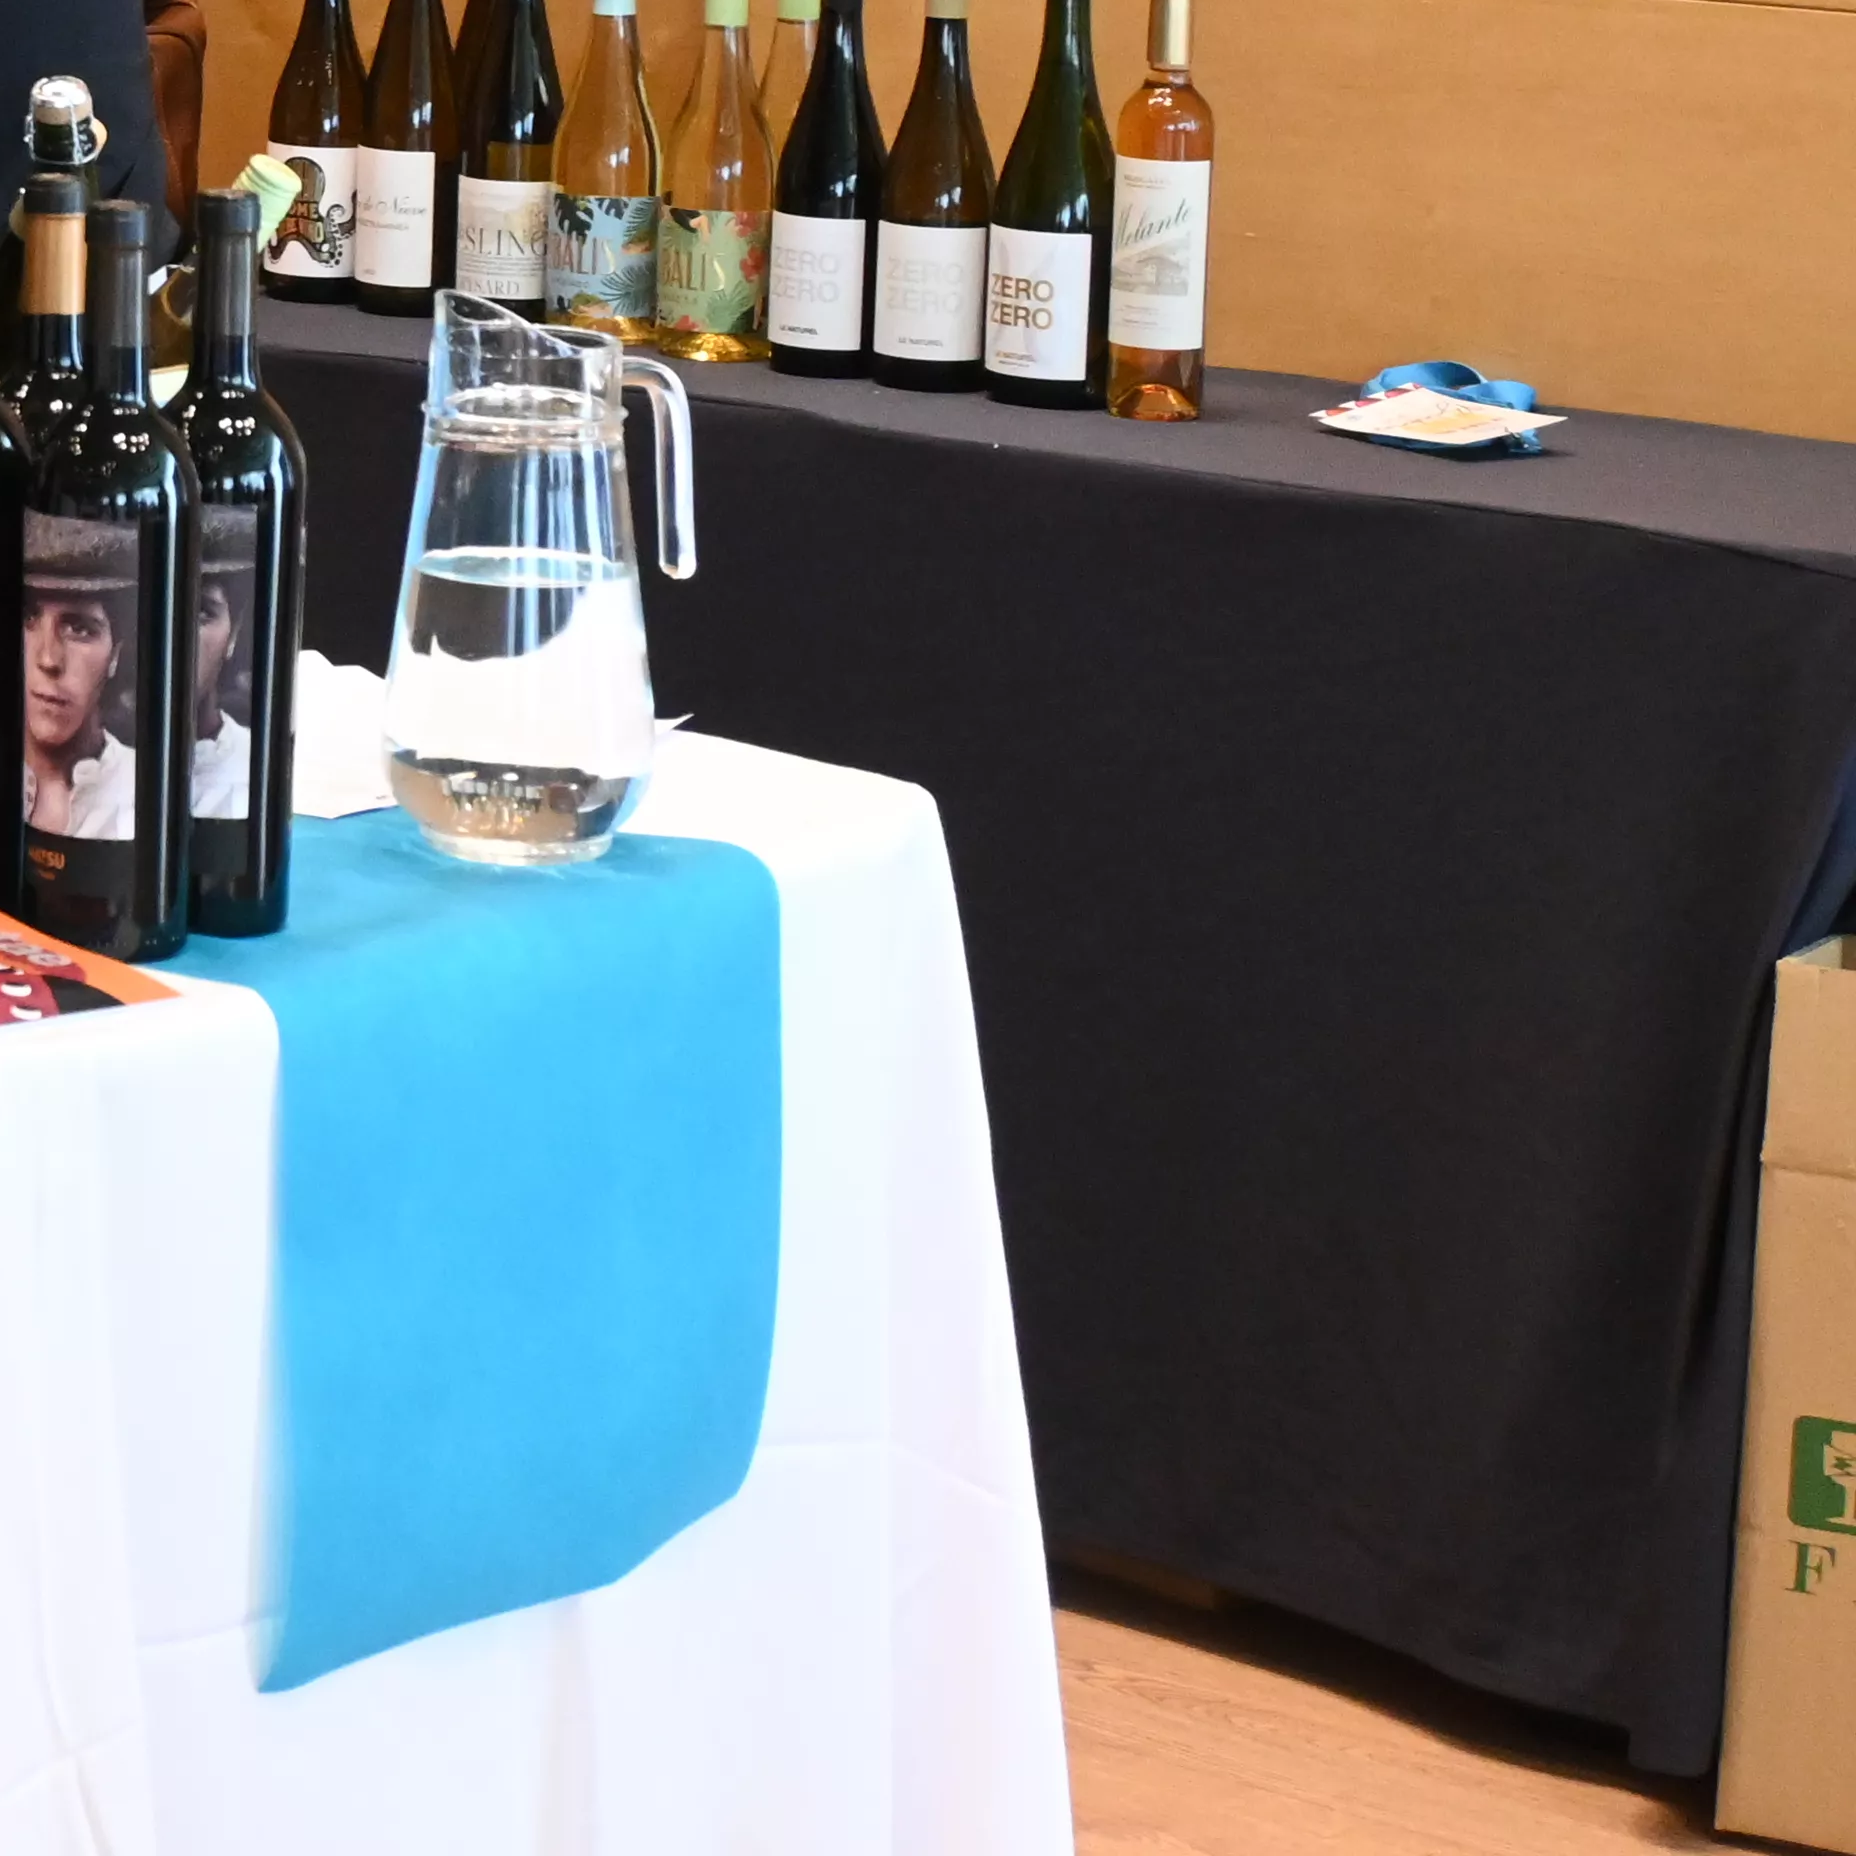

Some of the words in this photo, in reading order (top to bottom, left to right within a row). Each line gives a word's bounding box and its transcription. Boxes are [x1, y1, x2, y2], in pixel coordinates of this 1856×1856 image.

[773, 245, 840, 275] ZERO
[887, 256, 964, 285] ZERO
[771, 275, 840, 304] ZERO
[887, 285, 964, 315] ZERO
[991, 273, 1054, 303] ZERO
[990, 300, 1053, 331] ZERO
